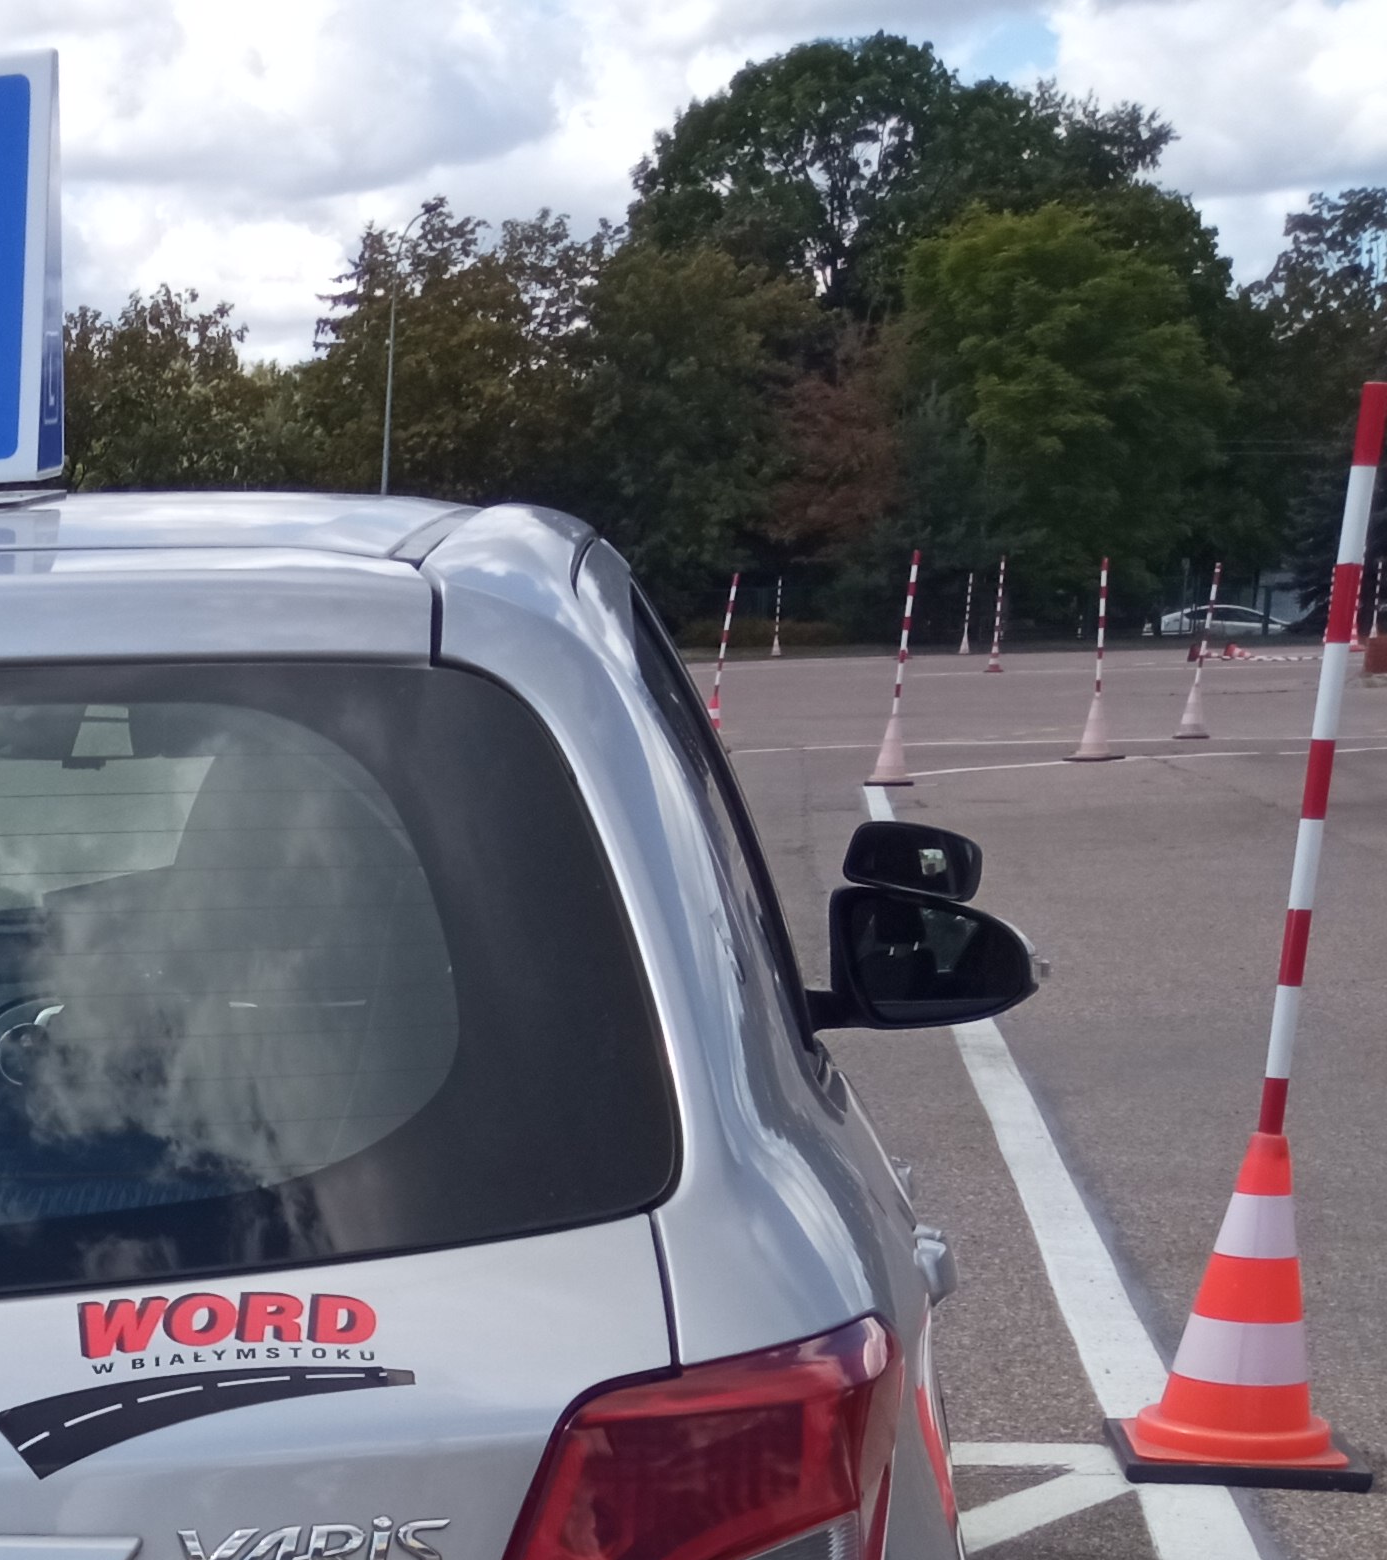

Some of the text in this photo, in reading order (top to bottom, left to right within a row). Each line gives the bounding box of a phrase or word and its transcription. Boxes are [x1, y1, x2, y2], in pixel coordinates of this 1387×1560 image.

[77, 1292, 377, 1360] WORD
[91, 1347, 376, 1375] W BIAŁYMSTOKU
